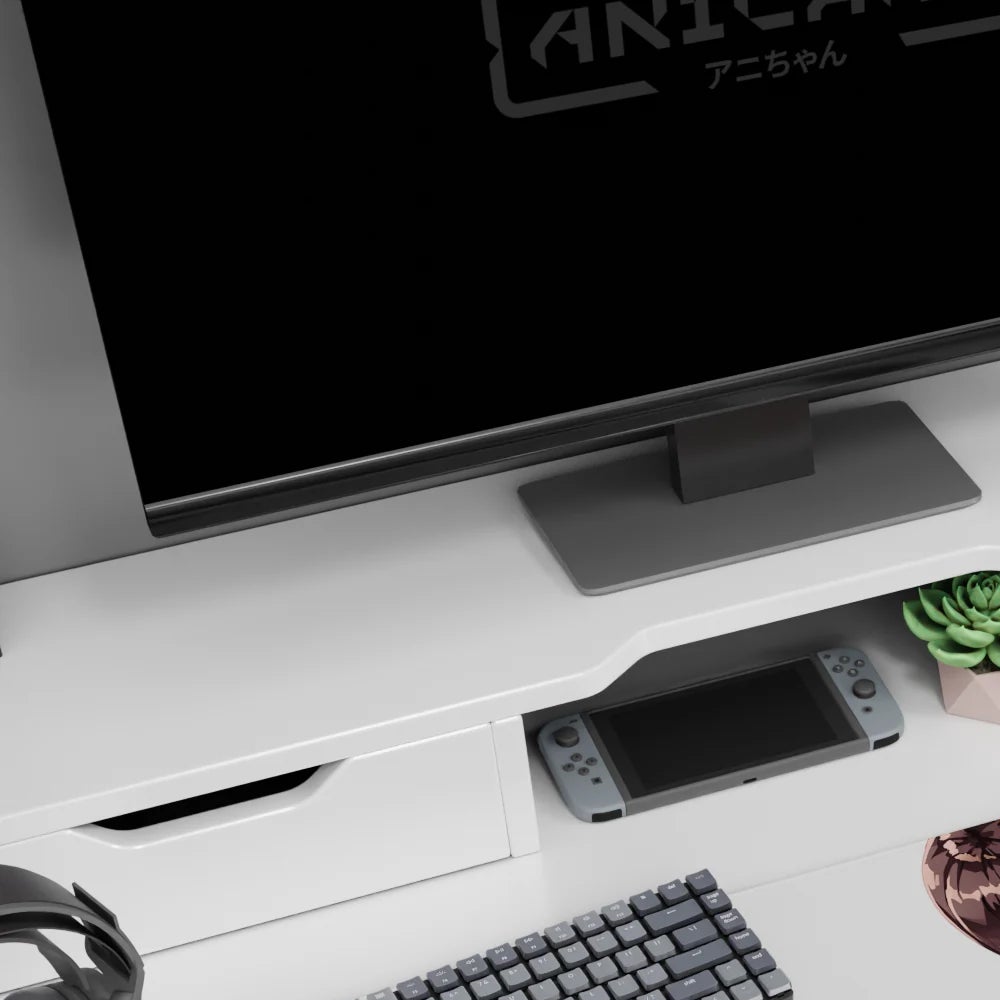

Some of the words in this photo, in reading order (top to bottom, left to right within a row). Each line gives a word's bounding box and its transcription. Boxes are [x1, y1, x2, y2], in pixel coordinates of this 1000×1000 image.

[704, 39, 848, 90] アニちゃん
